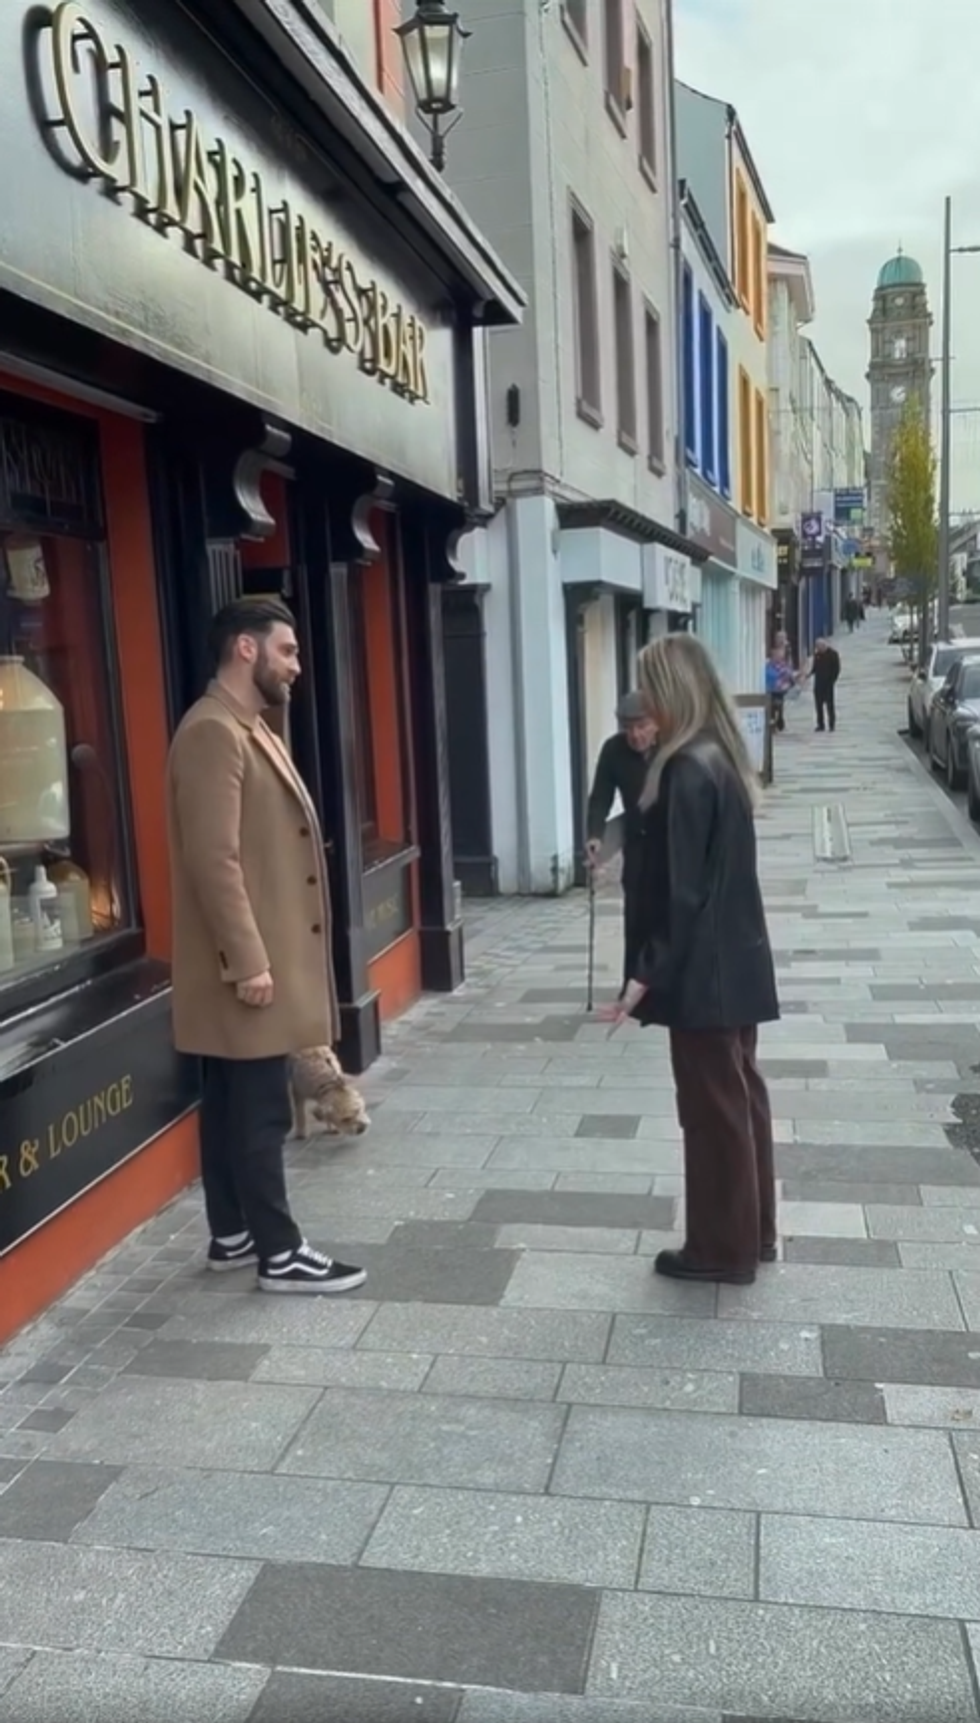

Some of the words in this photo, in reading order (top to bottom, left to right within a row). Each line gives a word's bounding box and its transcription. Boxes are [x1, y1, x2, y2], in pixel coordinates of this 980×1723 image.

[50, 2, 363, 353] CHARLIE'S
[374, 285, 429, 401] BAR
[19, 1139, 39, 1177] &
[48, 1074, 133, 1159] LOUNGE
